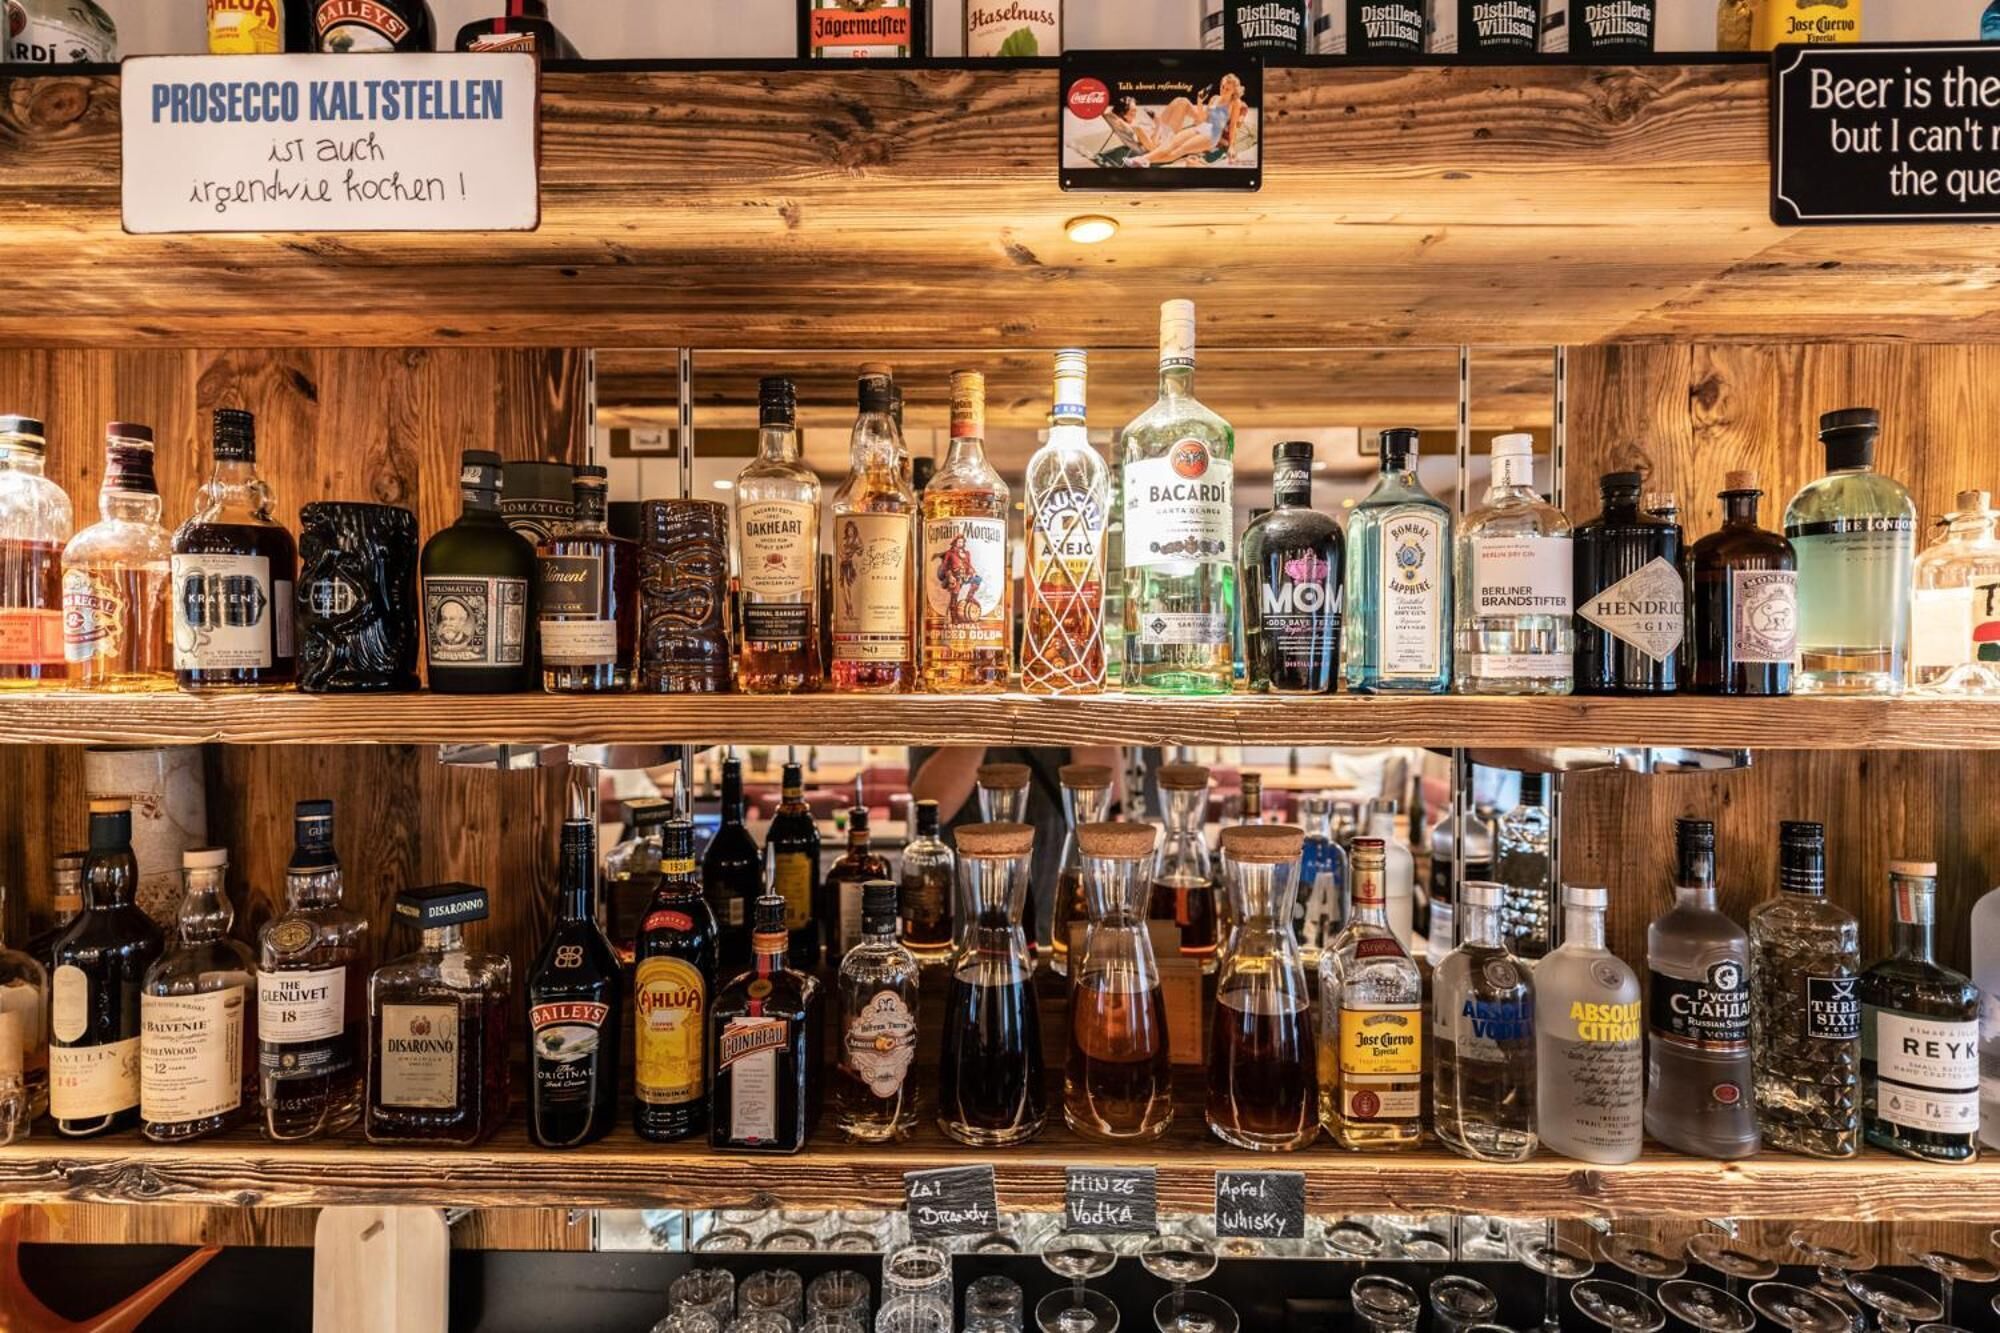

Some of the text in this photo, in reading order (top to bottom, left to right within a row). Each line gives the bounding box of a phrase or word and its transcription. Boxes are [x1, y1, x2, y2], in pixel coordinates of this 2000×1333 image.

[968, 1, 1055, 31] Haselnuss
[1237, 4, 1300, 26] Distillerie
[1361, 4, 1422, 27] Distillerie
[1473, 2, 1536, 22] Distillerie
[1585, 1, 1650, 22] Distillerie
[1240, 19, 1297, 41] Willisau
[1365, 20, 1419, 43] Willisau
[1477, 18, 1533, 39] Willisau
[1589, 18, 1648, 38] Willisau
[1786, 16, 1855, 34] Jose Cuervo
[1119, 82, 1193, 92] Talk about refreshing
[1810, 65, 2000, 109] Beer is the
[152, 79, 503, 123] PROSECCO KALTSTELLEN
[1830, 118, 1882, 153] but
[1891, 118, 1900, 152] I
[1908, 117, 1983, 152] can't
[268, 132, 384, 162] ist auch
[189, 169, 332, 213] irgendwie
[343, 168, 445, 202] kochen
[1889, 161, 2000, 203] the que
[1149, 481, 1225, 502] BACARDÍ
[746, 520, 802, 537] OAKHEART
[962, 521, 1001, 543] Morgan
[1391, 523, 1430, 541] BOMBAY
[1831, 520, 1862, 533] THE
[1388, 577, 1432, 596] SAPPHIRE
[1482, 586, 1532, 595] BERLINER
[1262, 583, 1343, 613] MOM
[1482, 596, 1567, 606] BRANDSTIFTER
[1644, 621, 1673, 632] GIN
[428, 898, 484, 919] DISARONNO
[262, 986, 327, 1001] GLENLIVET
[279, 981, 300, 990] THE
[636, 981, 701, 1016] KAHLÚA
[1670, 993, 1750, 1018] СТАНДА
[281, 1010, 297, 1023] 18
[532, 1006, 602, 1023] BAILEYS
[148, 1021, 207, 1033] BALVENIE
[388, 1039, 453, 1054] DISARONNO
[722, 1026, 784, 1061] COINTREAU
[1355, 1032, 1414, 1048] Jose Cuervo
[1903, 1037, 1976, 1060] REYK
[154, 1063, 167, 1074] 12
[537, 1069, 595, 1080] ORIGINAL
[1219, 1176, 1265, 1202] Apfel
